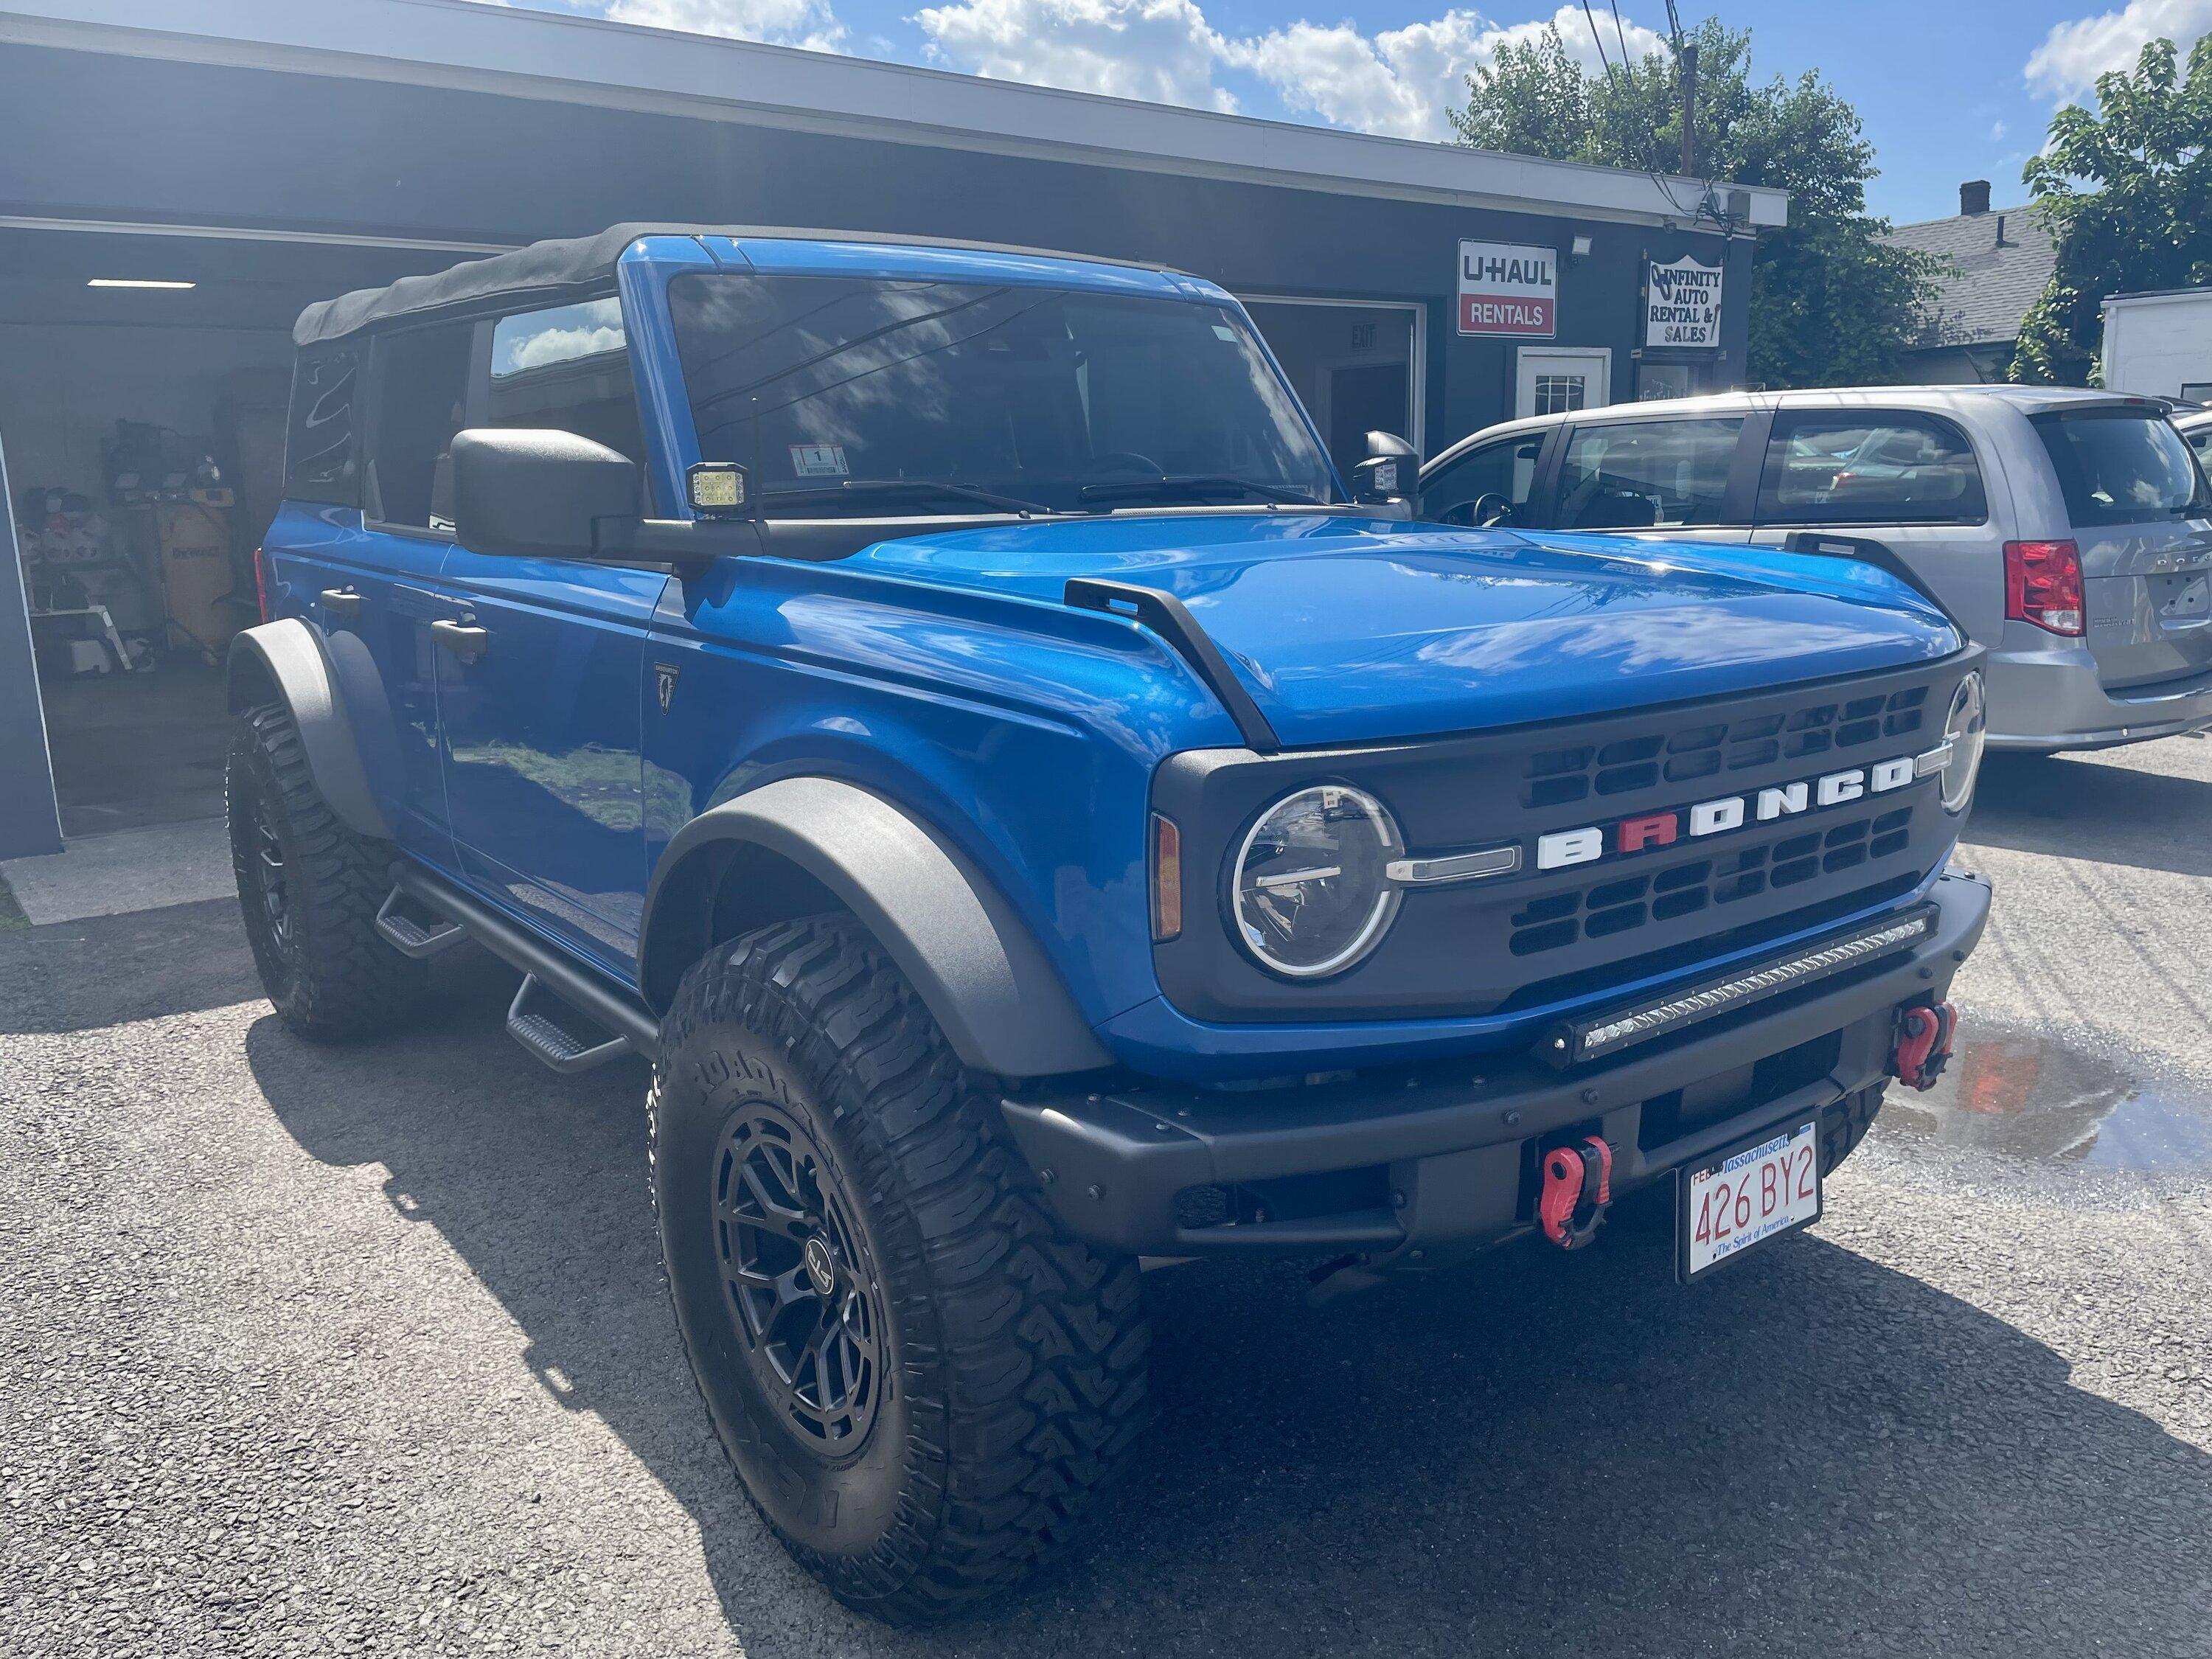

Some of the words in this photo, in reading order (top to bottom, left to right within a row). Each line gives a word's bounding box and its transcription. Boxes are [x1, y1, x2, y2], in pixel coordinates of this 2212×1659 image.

[1464, 255, 1552, 285] U-HAUL
[1662, 268, 1721, 288] INFINITY
[1674, 288, 1709, 305] AUTO
[1471, 303, 1543, 326] RENTALS
[1649, 305, 1700, 323] RENTAL
[1703, 307, 1713, 323] &
[1664, 325, 1706, 343] SALES
[1537, 757, 1913, 869] BRONCO
[1695, 1172, 1750, 1245] 426
[1761, 1145, 1814, 1217] BY2
[1717, 1242, 1731, 1256] The
[1733, 1232, 1753, 1249] Spirit
[1753, 1225, 1761, 1240] of
[1761, 1215, 1790, 1234] America
